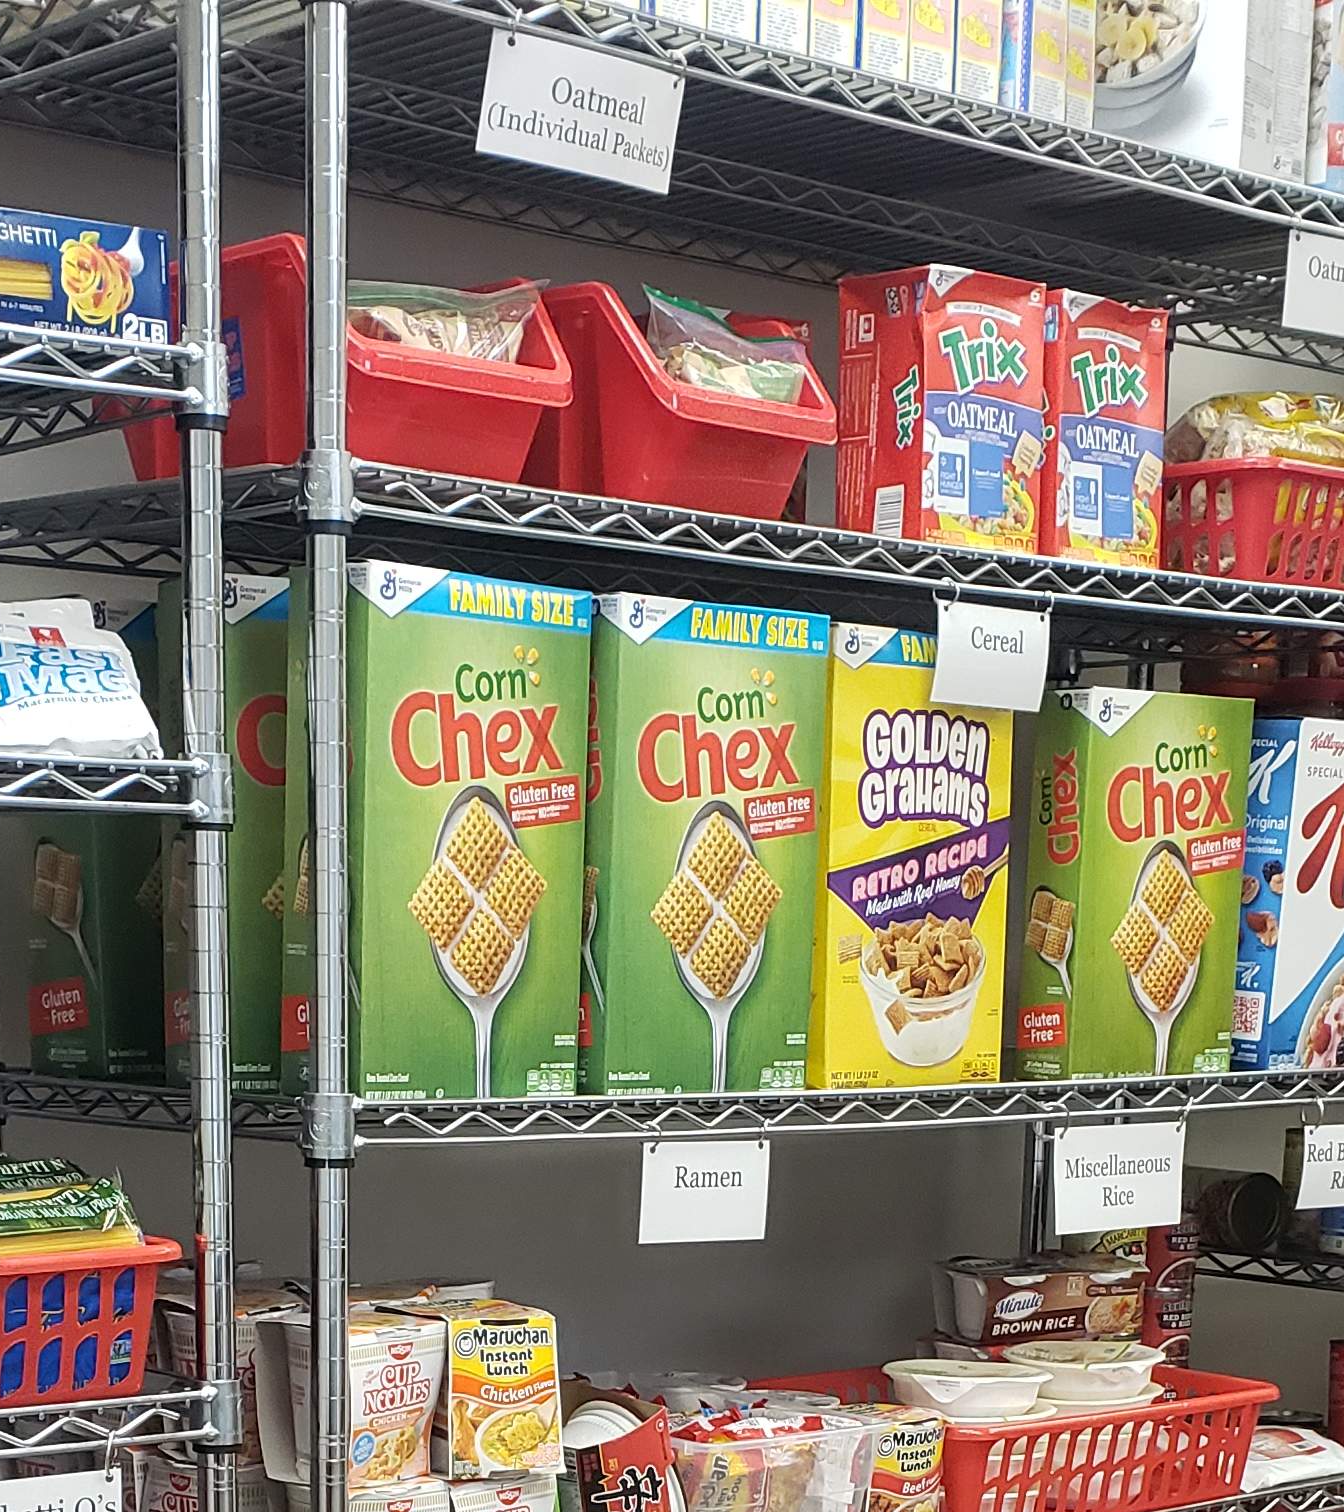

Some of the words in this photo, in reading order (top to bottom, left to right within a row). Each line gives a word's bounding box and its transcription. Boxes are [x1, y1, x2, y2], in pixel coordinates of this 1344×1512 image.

[551, 76, 646, 126] Oatmeal
[487, 101, 608, 152] (Individual
[611, 131, 669, 171] Packets)
[938, 318, 1028, 394] Trix
[947, 401, 1017, 438] OATMEAL
[448, 579, 526, 619] FAMILY
[530, 590, 575, 626] SIZE
[971, 626, 1025, 657] Cereal
[455, 662, 528, 704] Corn
[390, 690, 564, 788] Chex
[637, 712, 800, 802] Chex
[1307, 766, 1342, 779] SPECIAL
[508, 782, 547, 804] Gluten
[549, 781, 576, 800] Free
[1191, 840, 1220, 856] Gluten
[1223, 836, 1241, 849] Free
[1306, 1141, 1333, 1163] Red
[675, 1165, 744, 1189] Ramen
[1065, 1154, 1172, 1180] Miscellaneous
[1102, 1185, 1135, 1208] Rice
[992, 1316, 1037, 1335] BROWN
[1041, 1314, 1077, 1333] RICE
[480, 1348, 533, 1364] Instant
[486, 1362, 529, 1377] Lunch
[363, 1381, 431, 1414] NOODLES
[480, 1384, 533, 1400] Chicken
[897, 1446, 936, 1464] Instant
[900, 1458, 932, 1473] Lunch
[902, 1478, 924, 1495] Beef
